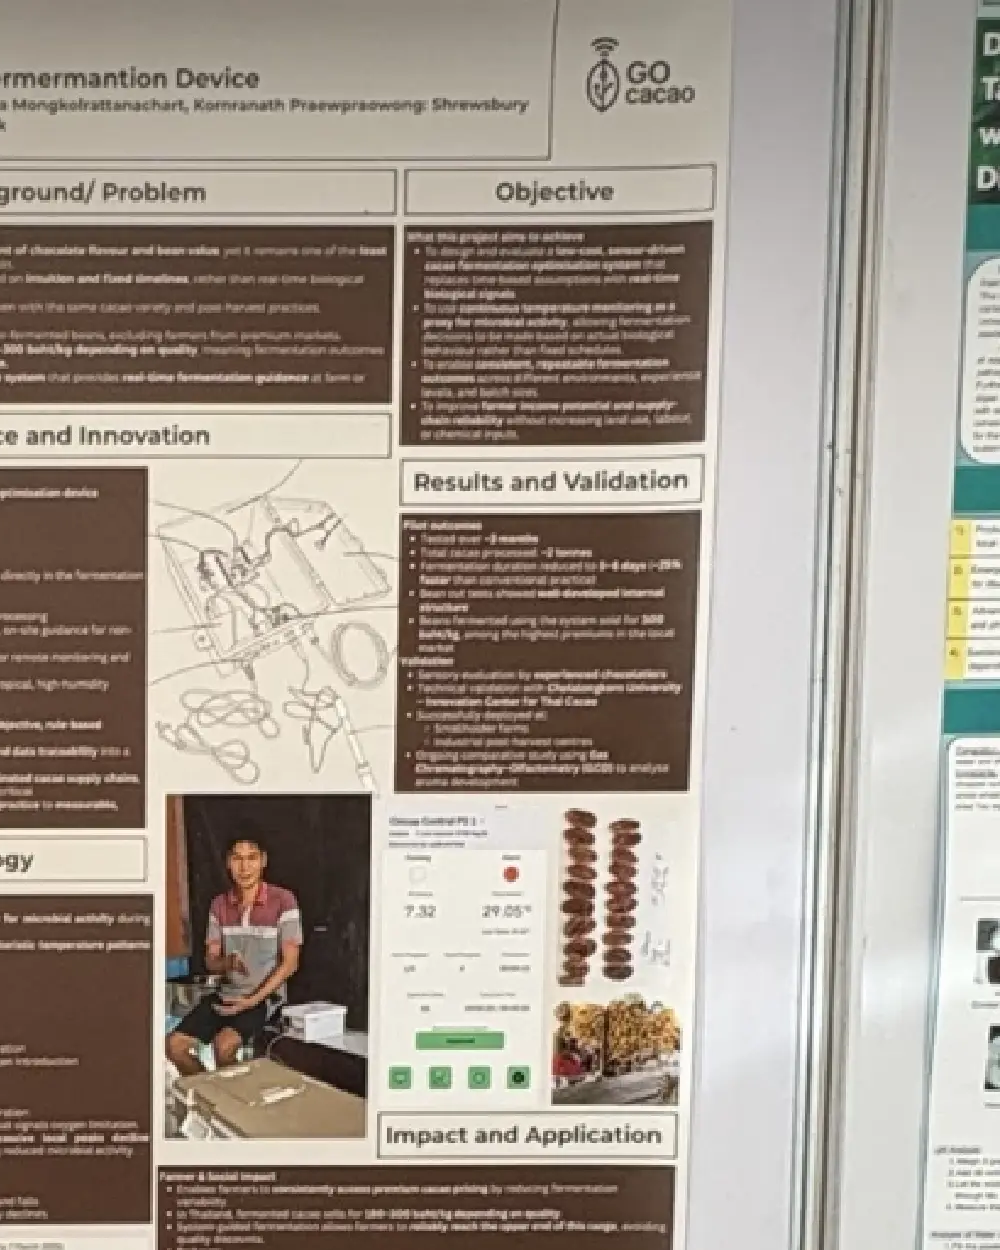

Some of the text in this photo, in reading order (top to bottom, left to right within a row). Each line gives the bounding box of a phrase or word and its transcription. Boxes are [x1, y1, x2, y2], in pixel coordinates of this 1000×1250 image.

[176, 66, 260, 88] Device
[626, 60, 671, 84] GO
[432, 97, 530, 115] Shrewsbury
[625, 86, 696, 104] cacao
[103, 180, 206, 203] Problem
[495, 180, 615, 207] Objective
[26, 425, 72, 446] and
[79, 424, 210, 446] Innovation
[414, 469, 689, 492] Results and Validation
[386, 1124, 662, 1147] Impact and Application
